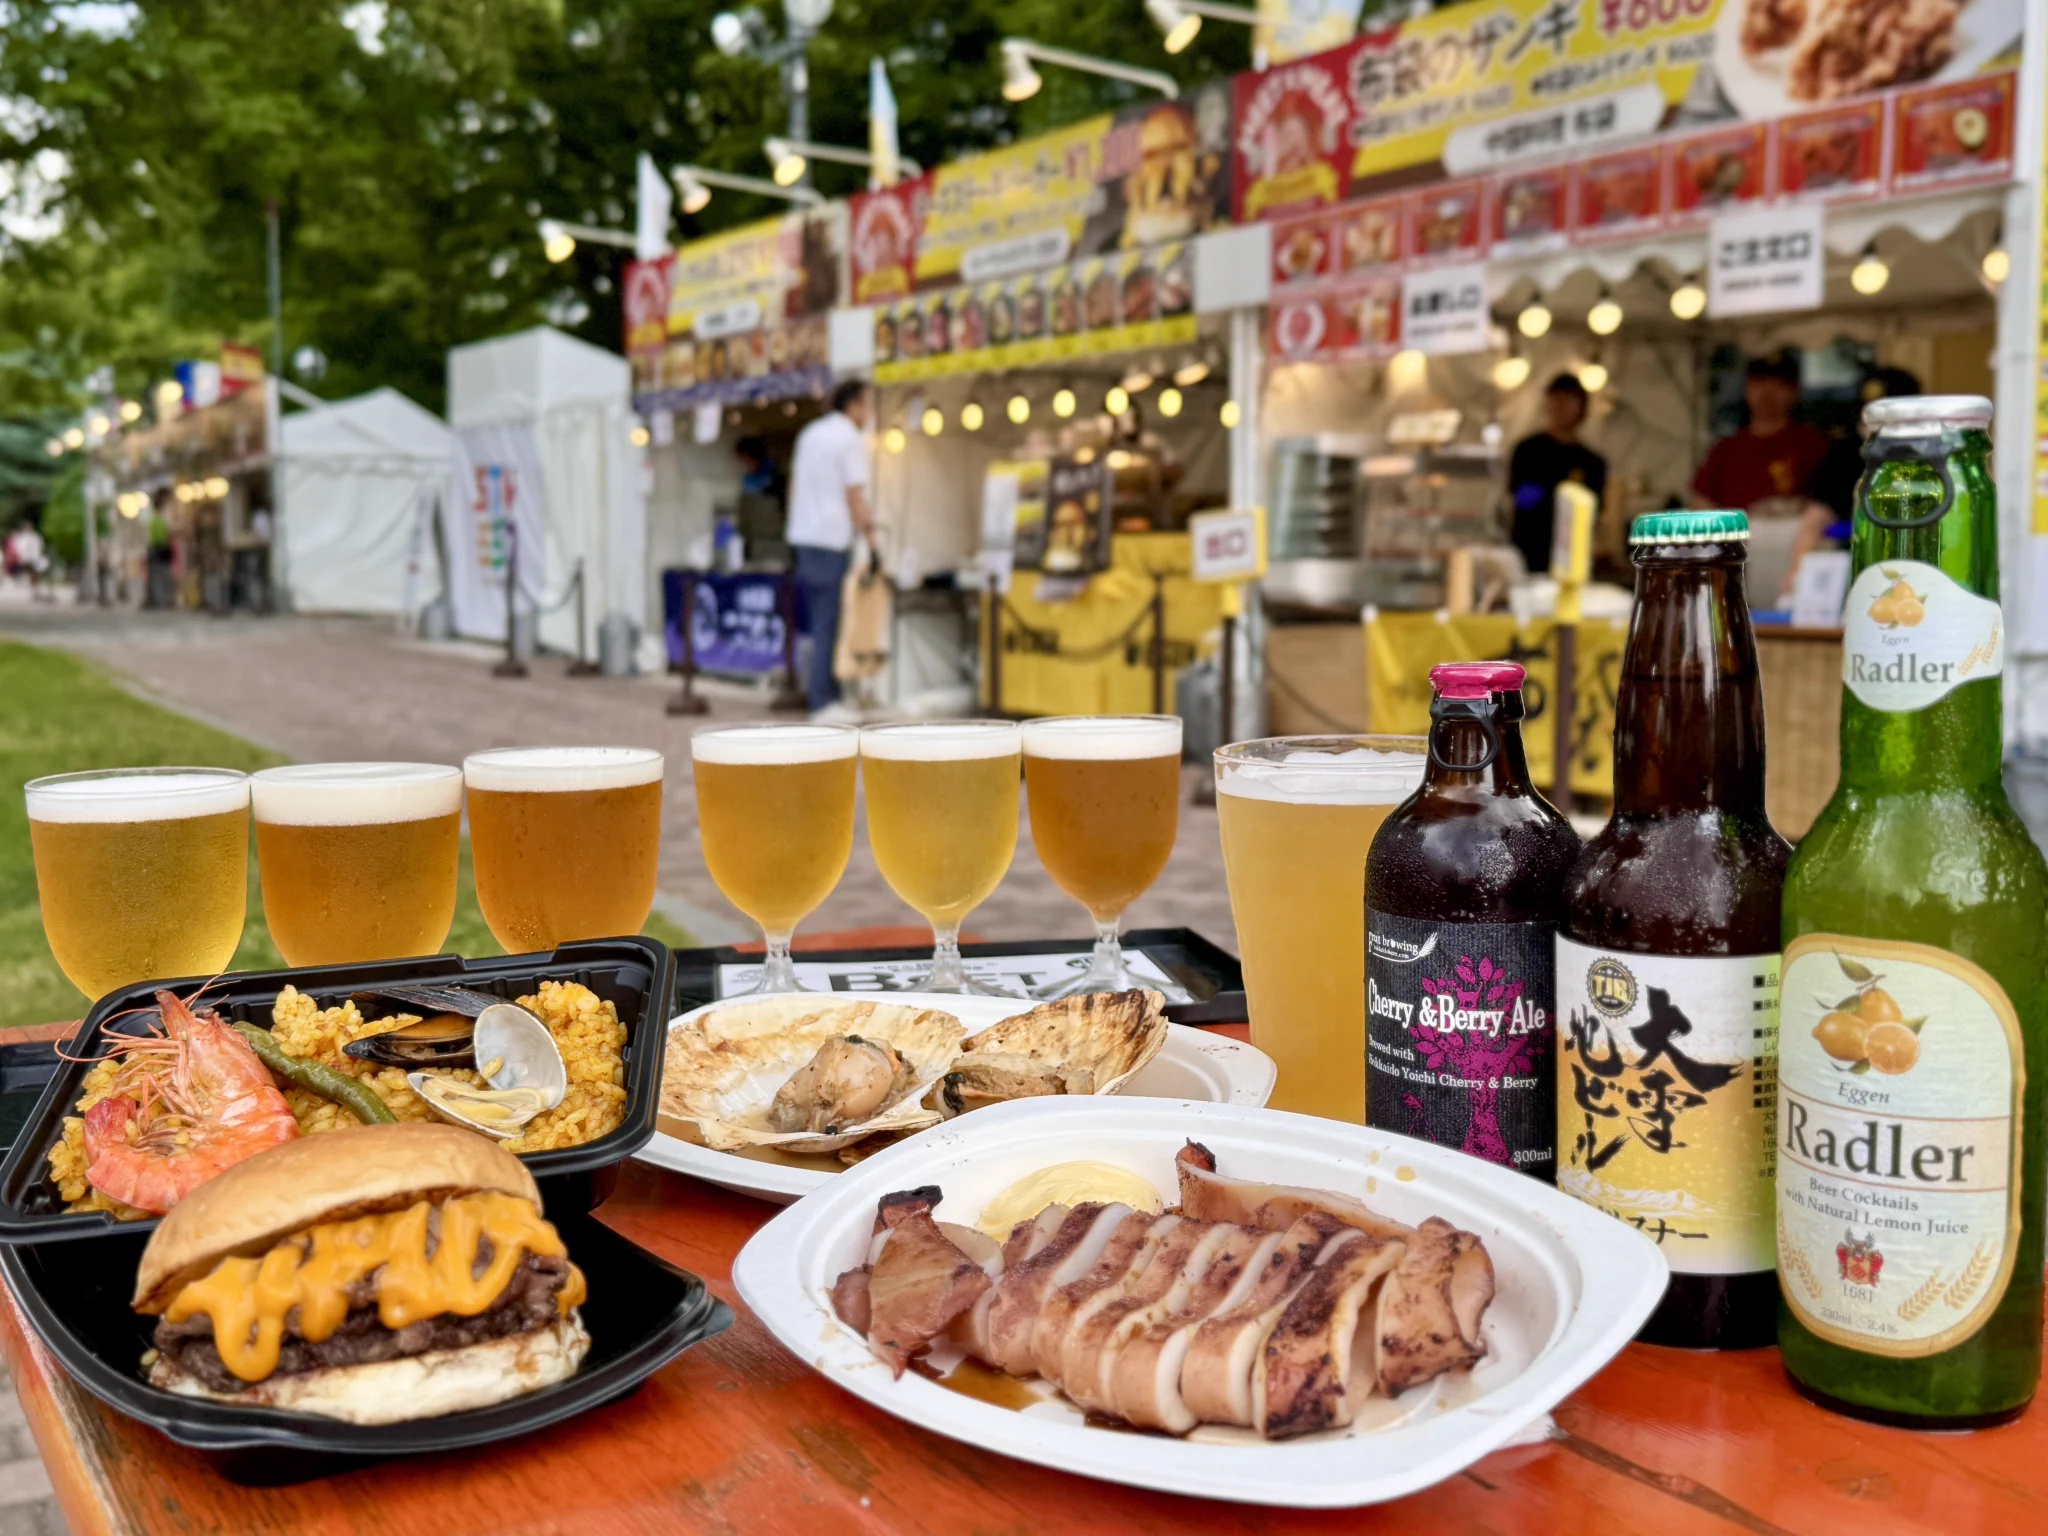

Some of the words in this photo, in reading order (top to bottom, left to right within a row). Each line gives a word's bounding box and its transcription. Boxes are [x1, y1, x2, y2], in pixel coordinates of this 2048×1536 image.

[1851, 652, 1955, 684] Radler
[1382, 934, 1419, 956] brwing
[1368, 977, 1414, 1029] Cherry
[1508, 995, 1546, 1035] Ale
[1368, 1033, 1391, 1057] Brewed
[1392, 1047, 1415, 1062] with
[1401, 1066, 1436, 1085] Yoichi
[1439, 1074, 1485, 1091] Cherry
[1488, 1077, 1500, 1089] &
[1503, 1076, 1538, 1090] Berry
[1838, 1082, 1890, 1105] Eggen
[1785, 1098, 1975, 1183] Radler
[1513, 1147, 1552, 1164] 300ml
[1809, 1176, 1838, 1198] Beer
[1841, 1187, 1919, 1211] Cocktails
[1785, 1186, 1805, 1206] with
[1807, 1198, 1860, 1222] Natural
[1864, 1211, 1922, 1232] Lemon
[1927, 1219, 1969, 1236] Juice
[1842, 1284, 1874, 1302] 1681
